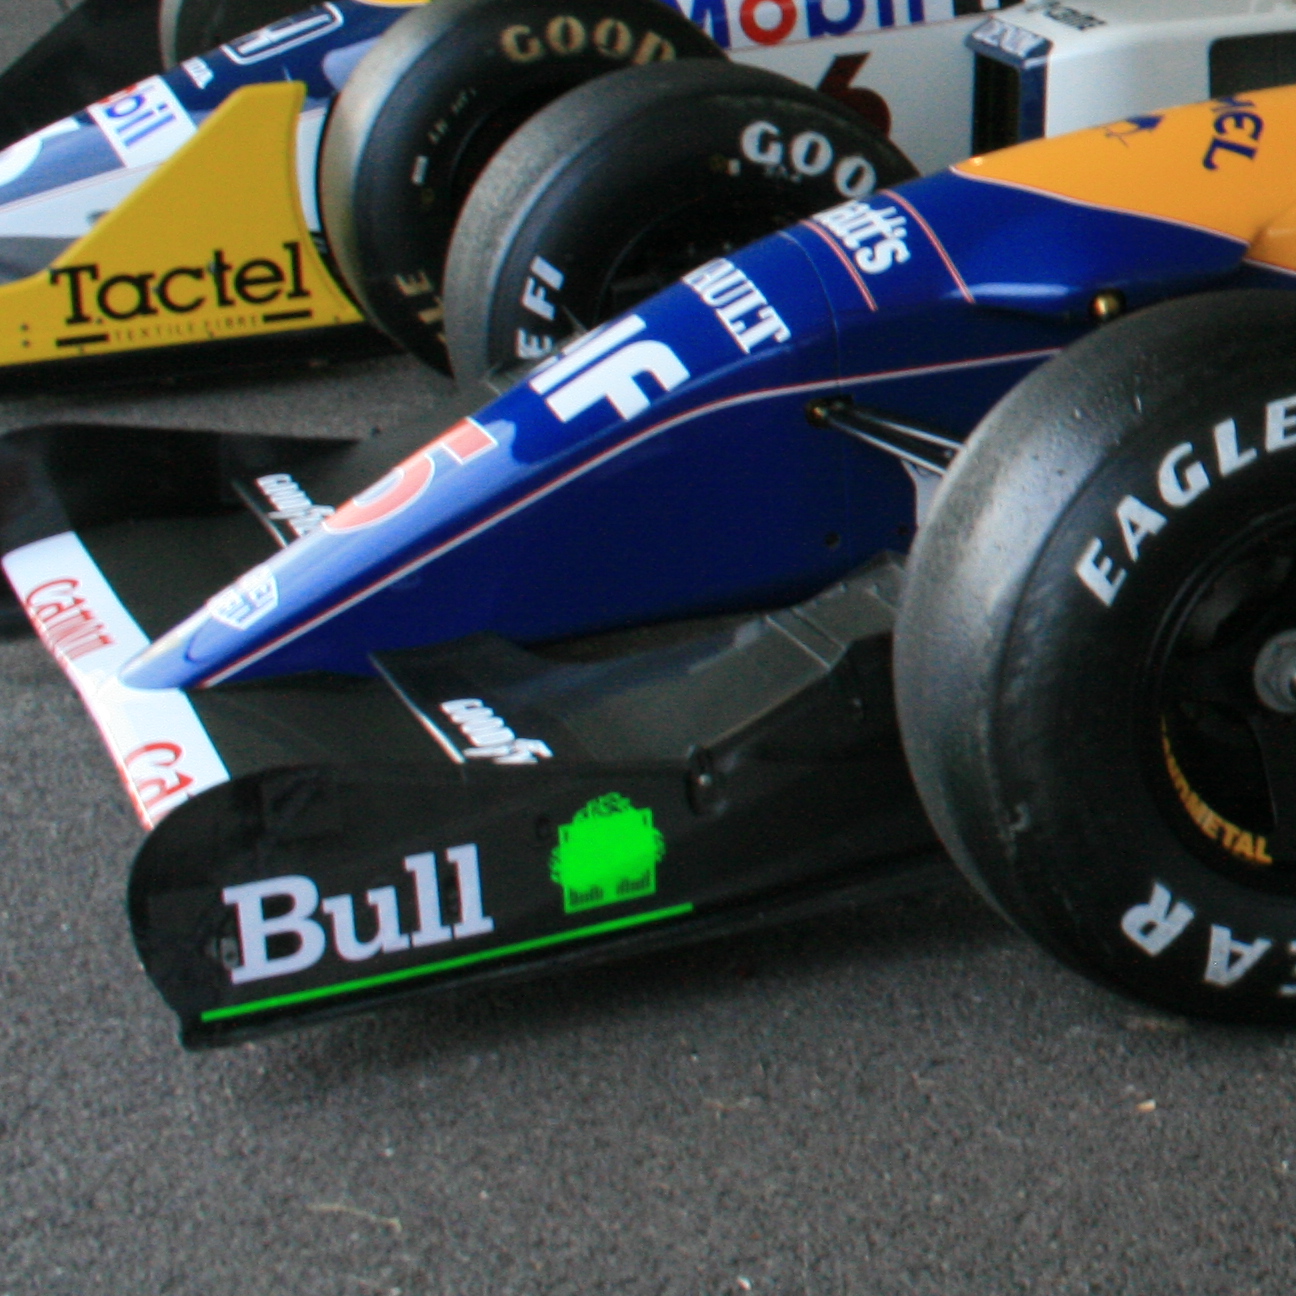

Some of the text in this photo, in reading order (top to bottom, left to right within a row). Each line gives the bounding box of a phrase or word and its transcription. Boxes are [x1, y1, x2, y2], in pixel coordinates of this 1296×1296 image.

[50, 241, 312, 325] Tactel
[114, 320, 194, 342] TEXTILE
[221, 842, 495, 986] Bull
